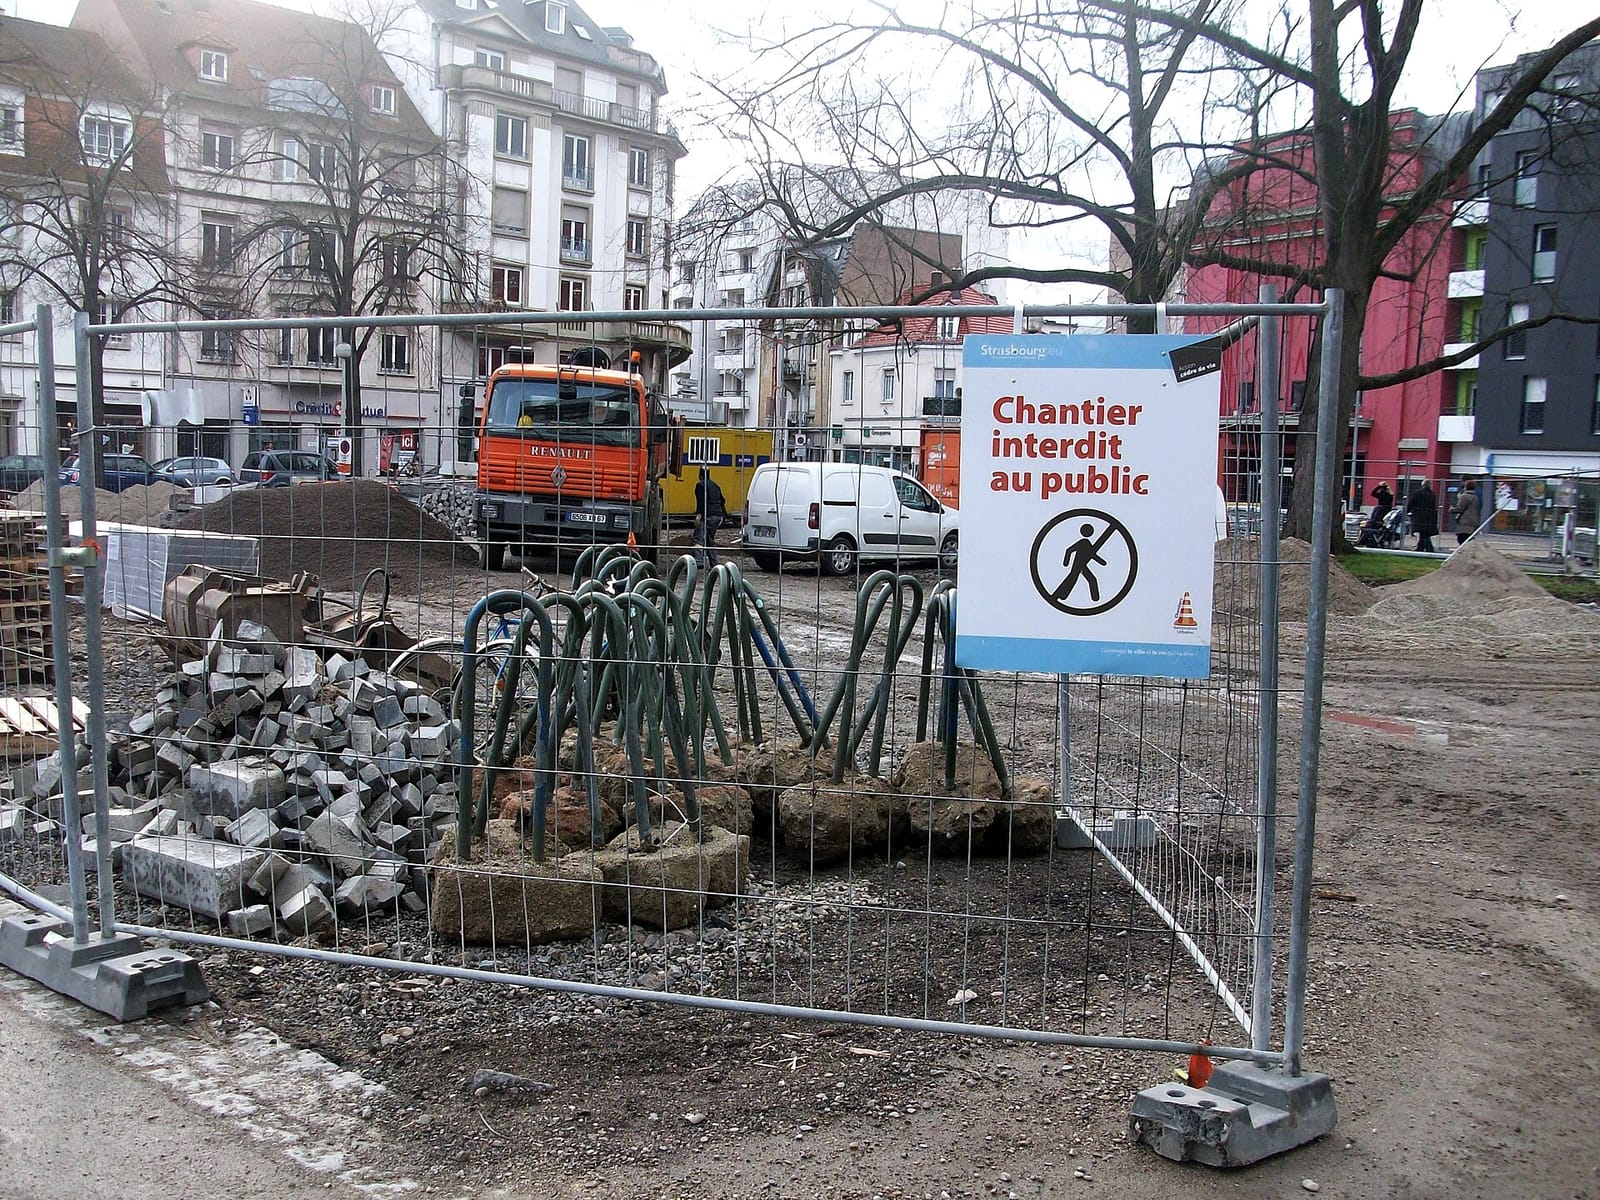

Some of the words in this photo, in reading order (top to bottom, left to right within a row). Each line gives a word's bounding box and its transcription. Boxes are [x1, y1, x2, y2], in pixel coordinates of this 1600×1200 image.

[992, 395, 1143, 426] Chantier
[531, 446, 591, 459] RENAULT
[991, 429, 1123, 460] interdit
[990, 470, 1032, 492] au
[1040, 465, 1149, 500] public
